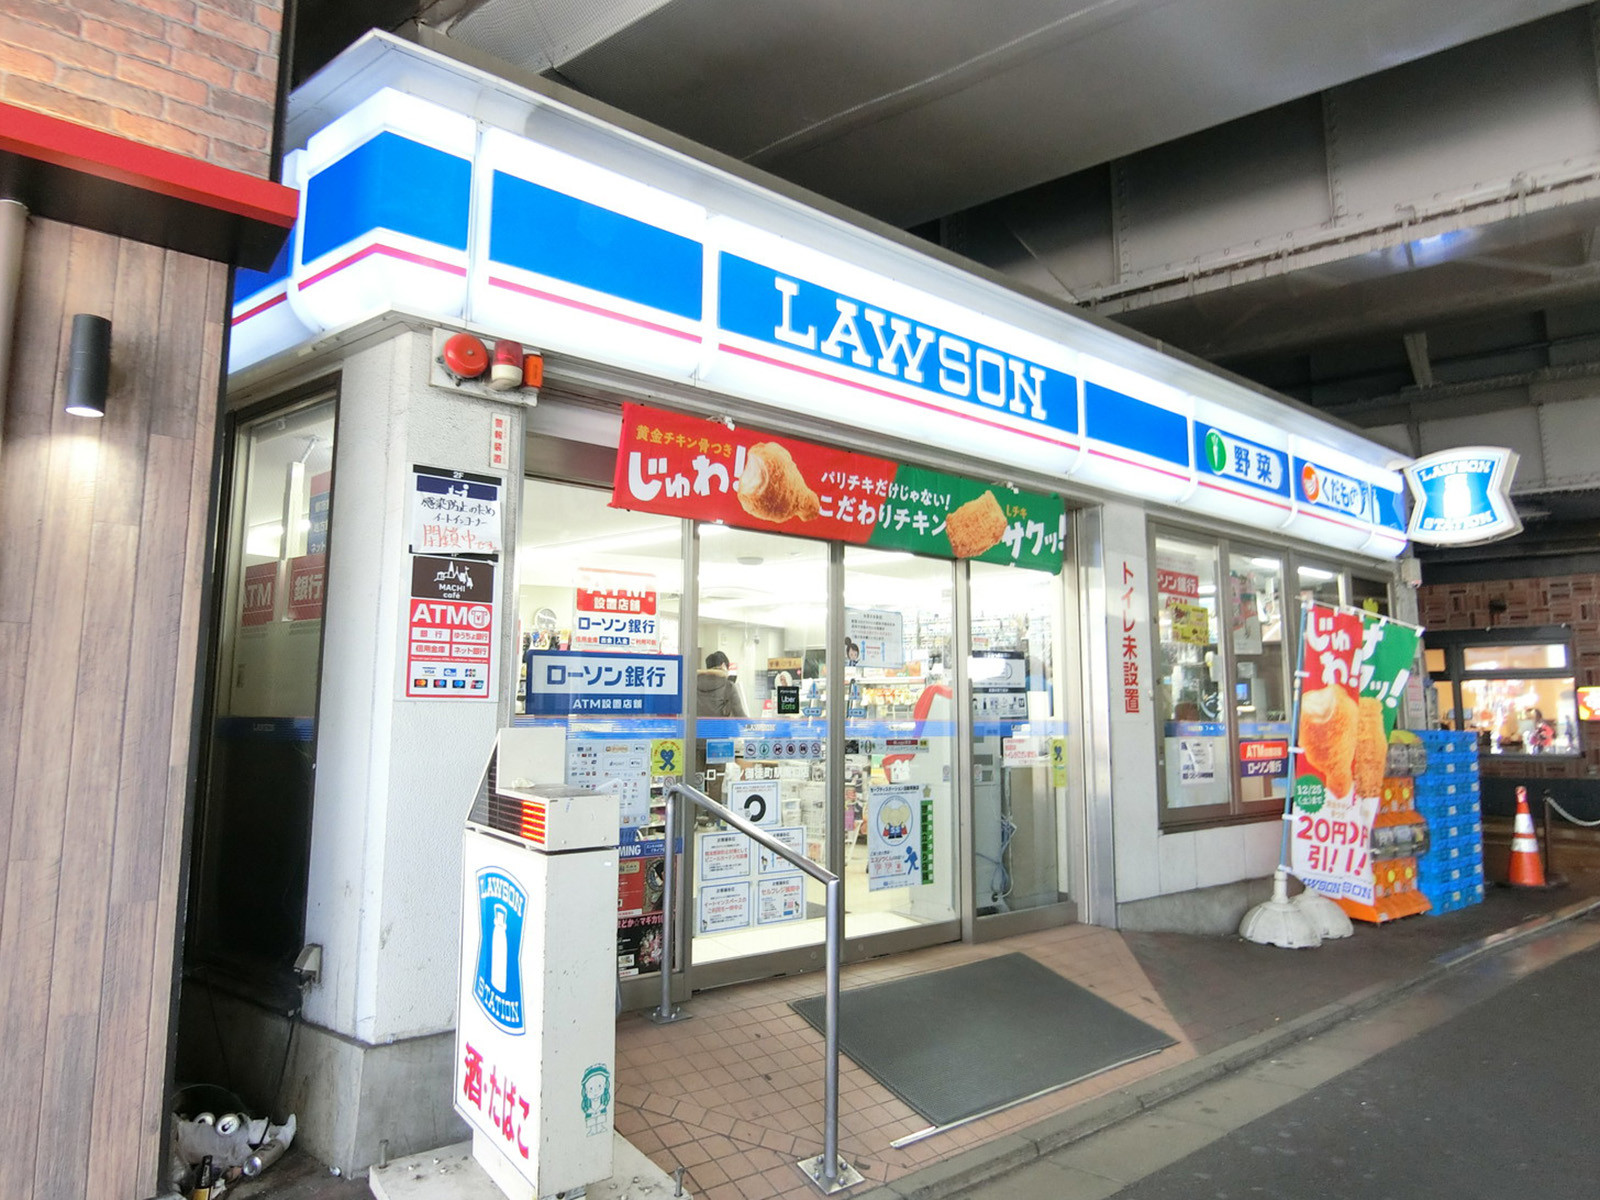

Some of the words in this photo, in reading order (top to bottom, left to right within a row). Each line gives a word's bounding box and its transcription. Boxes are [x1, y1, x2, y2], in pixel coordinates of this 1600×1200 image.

[774, 276, 1047, 420] LAWSON
[635, 424, 732, 458] 黄金チキン骨つき
[628, 444, 746, 501] じゅわ!
[1233, 444, 1273, 484] 野菜
[818, 494, 948, 537] こだわりチキン
[1001, 511, 1067, 560] サクッ!
[294, 573, 323, 601] 銀行
[438, 583, 466, 592] MACHI
[1158, 573, 1198, 594] ソン銀行
[412, 603, 468, 625] ATM
[578, 617, 655, 633] ローソン銀行
[454, 647, 487, 656] ネット銀行
[1120, 561, 1140, 714] トイレ未設置
[547, 665, 666, 688] ローソン銀行
[781, 695, 796, 703] Uber
[480, 877, 524, 918] LAWSON
[477, 975, 519, 1024] STATION
[463, 1040, 530, 1160] 酒・たばこ
